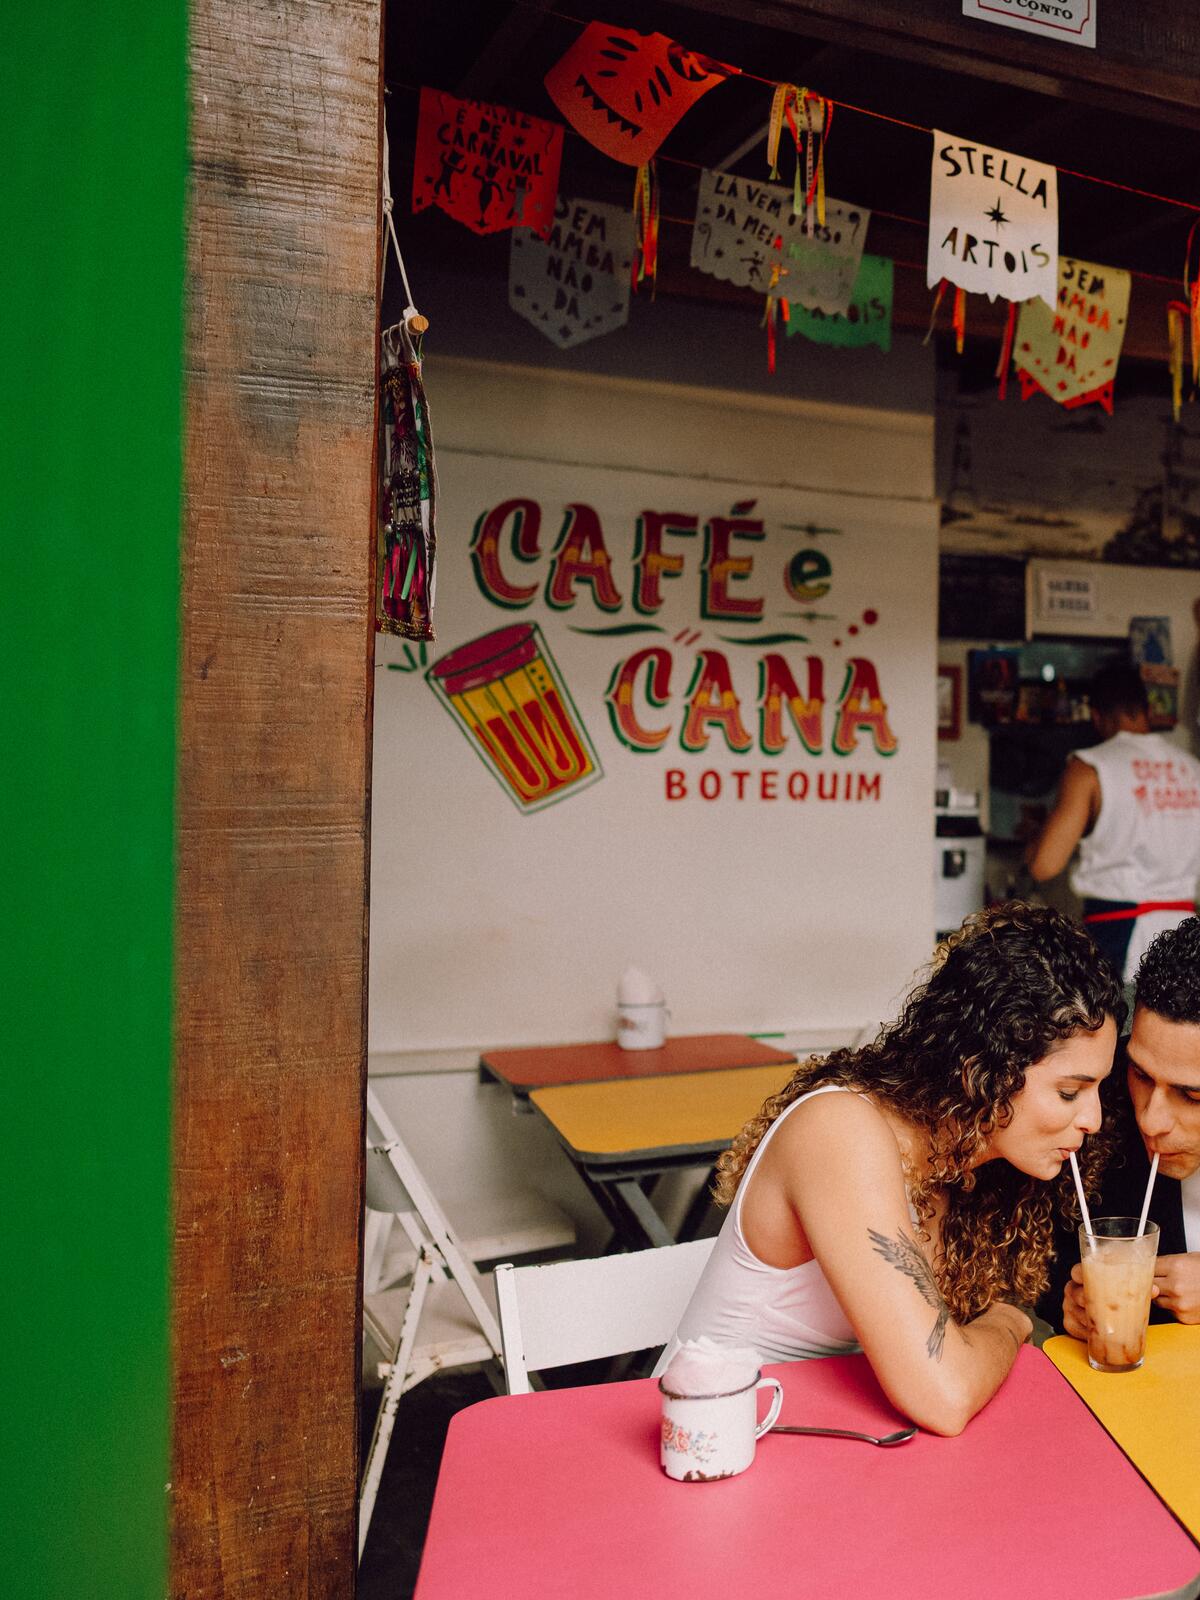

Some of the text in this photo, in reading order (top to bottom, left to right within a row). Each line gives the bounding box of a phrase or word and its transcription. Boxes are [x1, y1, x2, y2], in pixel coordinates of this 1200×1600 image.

[1016, 0, 1073, 20] CONTO
[437, 123, 543, 175] CARNAVAL
[940, 145, 1048, 208] STELLA
[555, 199, 606, 241] SEM
[716, 204, 736, 226] DA
[747, 185, 782, 218] VEM
[548, 224, 614, 274] AMBA
[941, 227, 1050, 273] ARTOIS
[1062, 259, 1106, 296] SEM
[1058, 286, 1110, 333] AMBA
[470, 497, 766, 622] CAFÉ
[605, 645, 898, 756] CANA
[665, 768, 882, 802] BOTEQUIM
